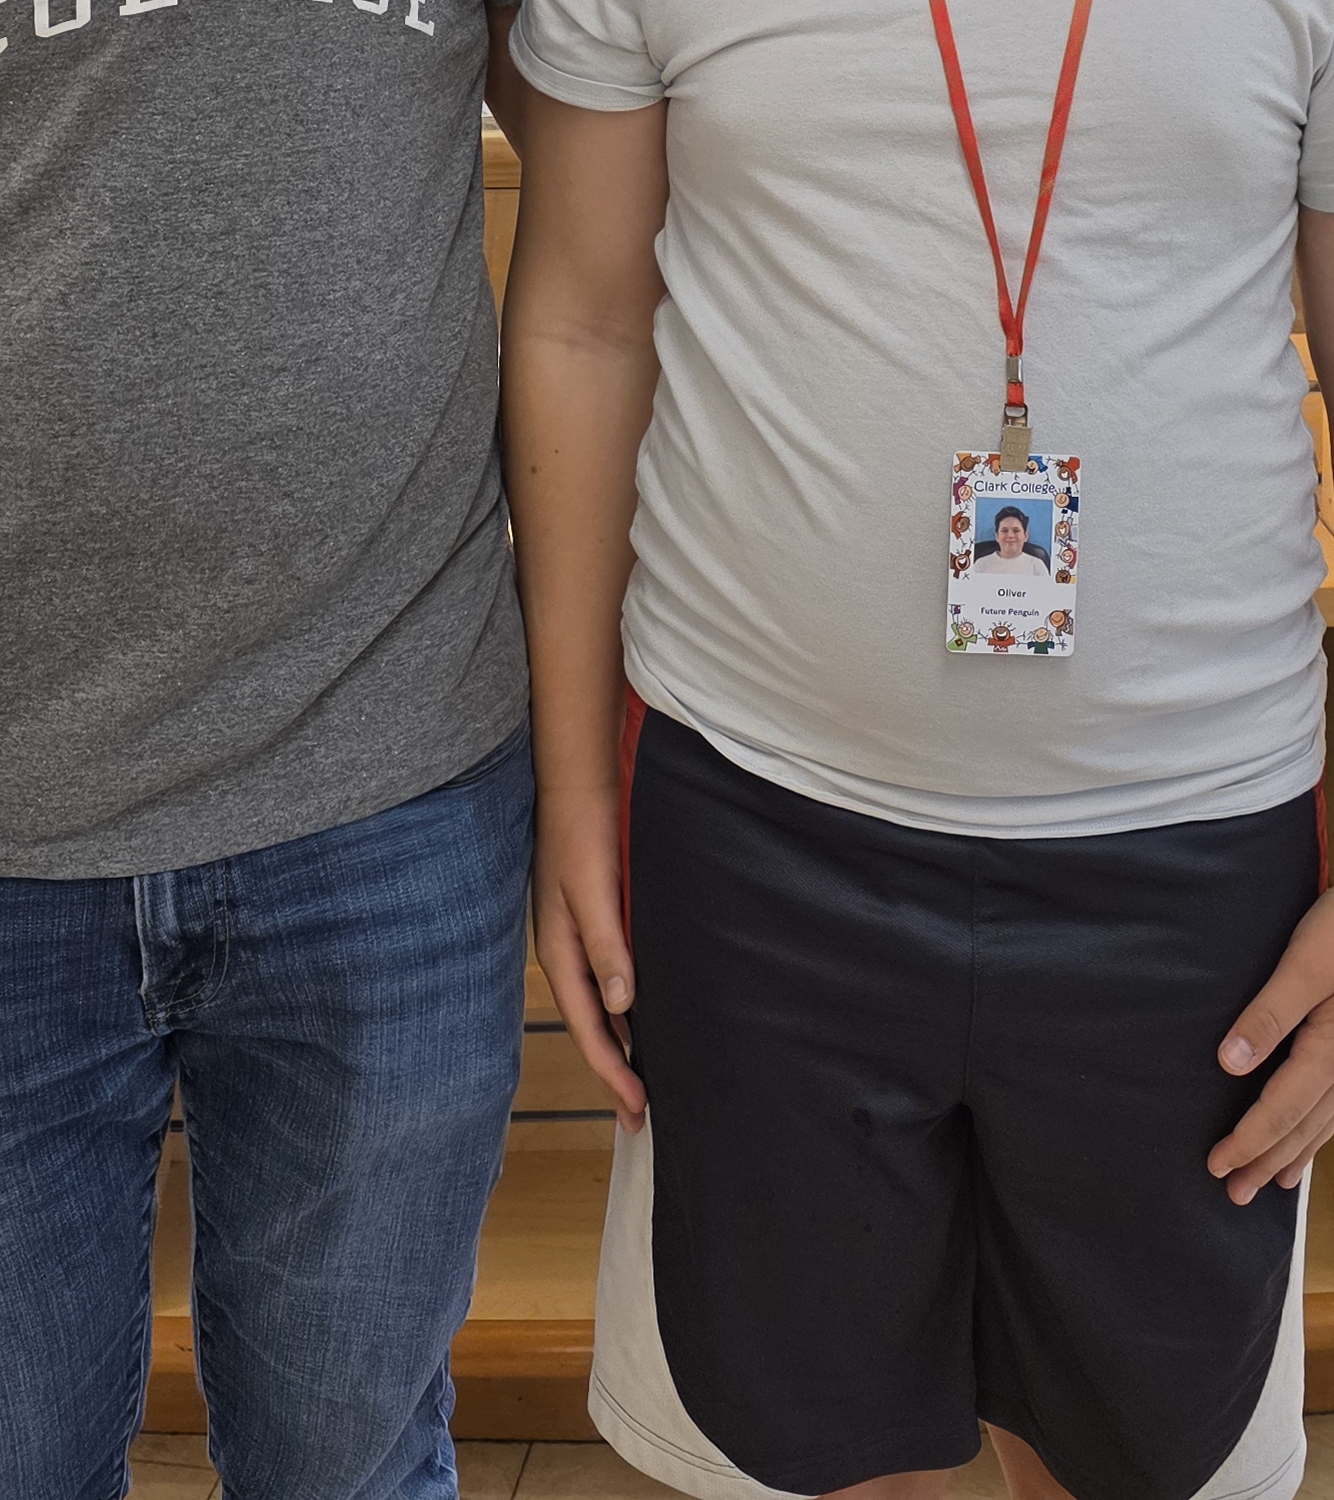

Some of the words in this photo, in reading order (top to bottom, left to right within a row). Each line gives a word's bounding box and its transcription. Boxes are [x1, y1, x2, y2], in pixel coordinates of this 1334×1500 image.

[974, 480, 1008, 493] Clark
[1011, 481, 1056, 495] College
[997, 588, 1027, 599] Oliver
[980, 607, 1006, 616] Future
[1008, 607, 1040, 618] Penguin
